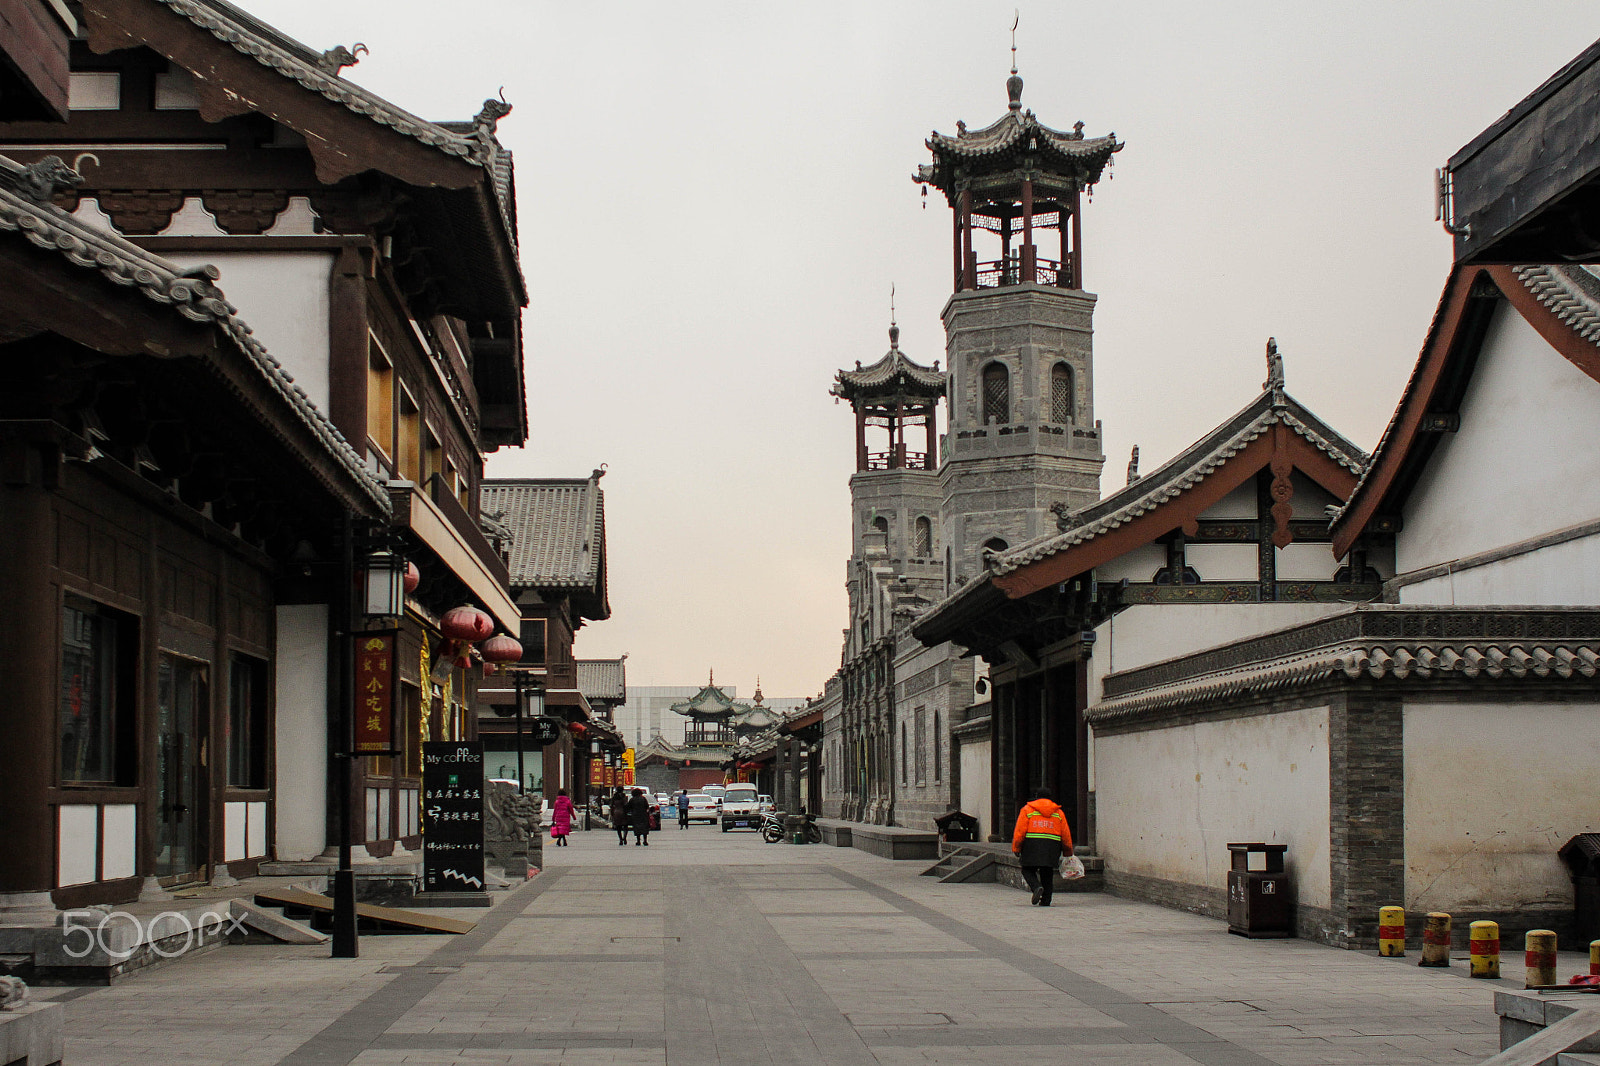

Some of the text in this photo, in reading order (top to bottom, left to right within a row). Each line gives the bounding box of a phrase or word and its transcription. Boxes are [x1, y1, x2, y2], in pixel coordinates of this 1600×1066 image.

[539, 722, 552, 731] My
[426, 747, 481, 765] My coffee
